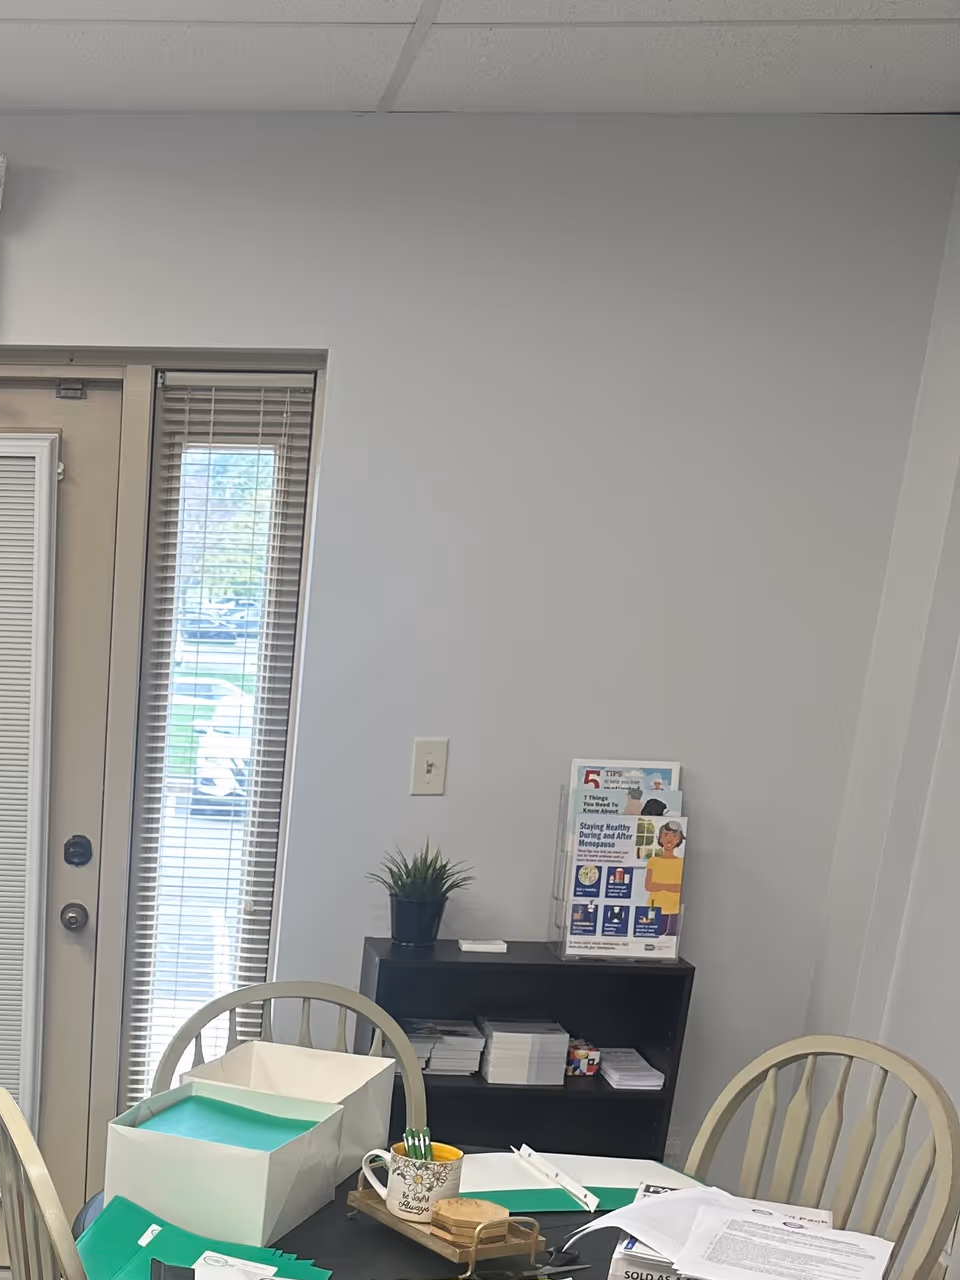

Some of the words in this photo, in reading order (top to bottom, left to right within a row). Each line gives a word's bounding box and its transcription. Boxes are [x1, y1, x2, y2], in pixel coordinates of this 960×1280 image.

[584, 770, 600, 789] 5
[580, 822, 604, 832] Staying
[606, 823, 631, 832] Healthy
[579, 831, 601, 840] During
[578, 840, 615, 848] Menopause
[402, 1191, 409, 1200] Be
[411, 1194, 430, 1203] Joyful
[398, 1200, 430, 1215] Always
